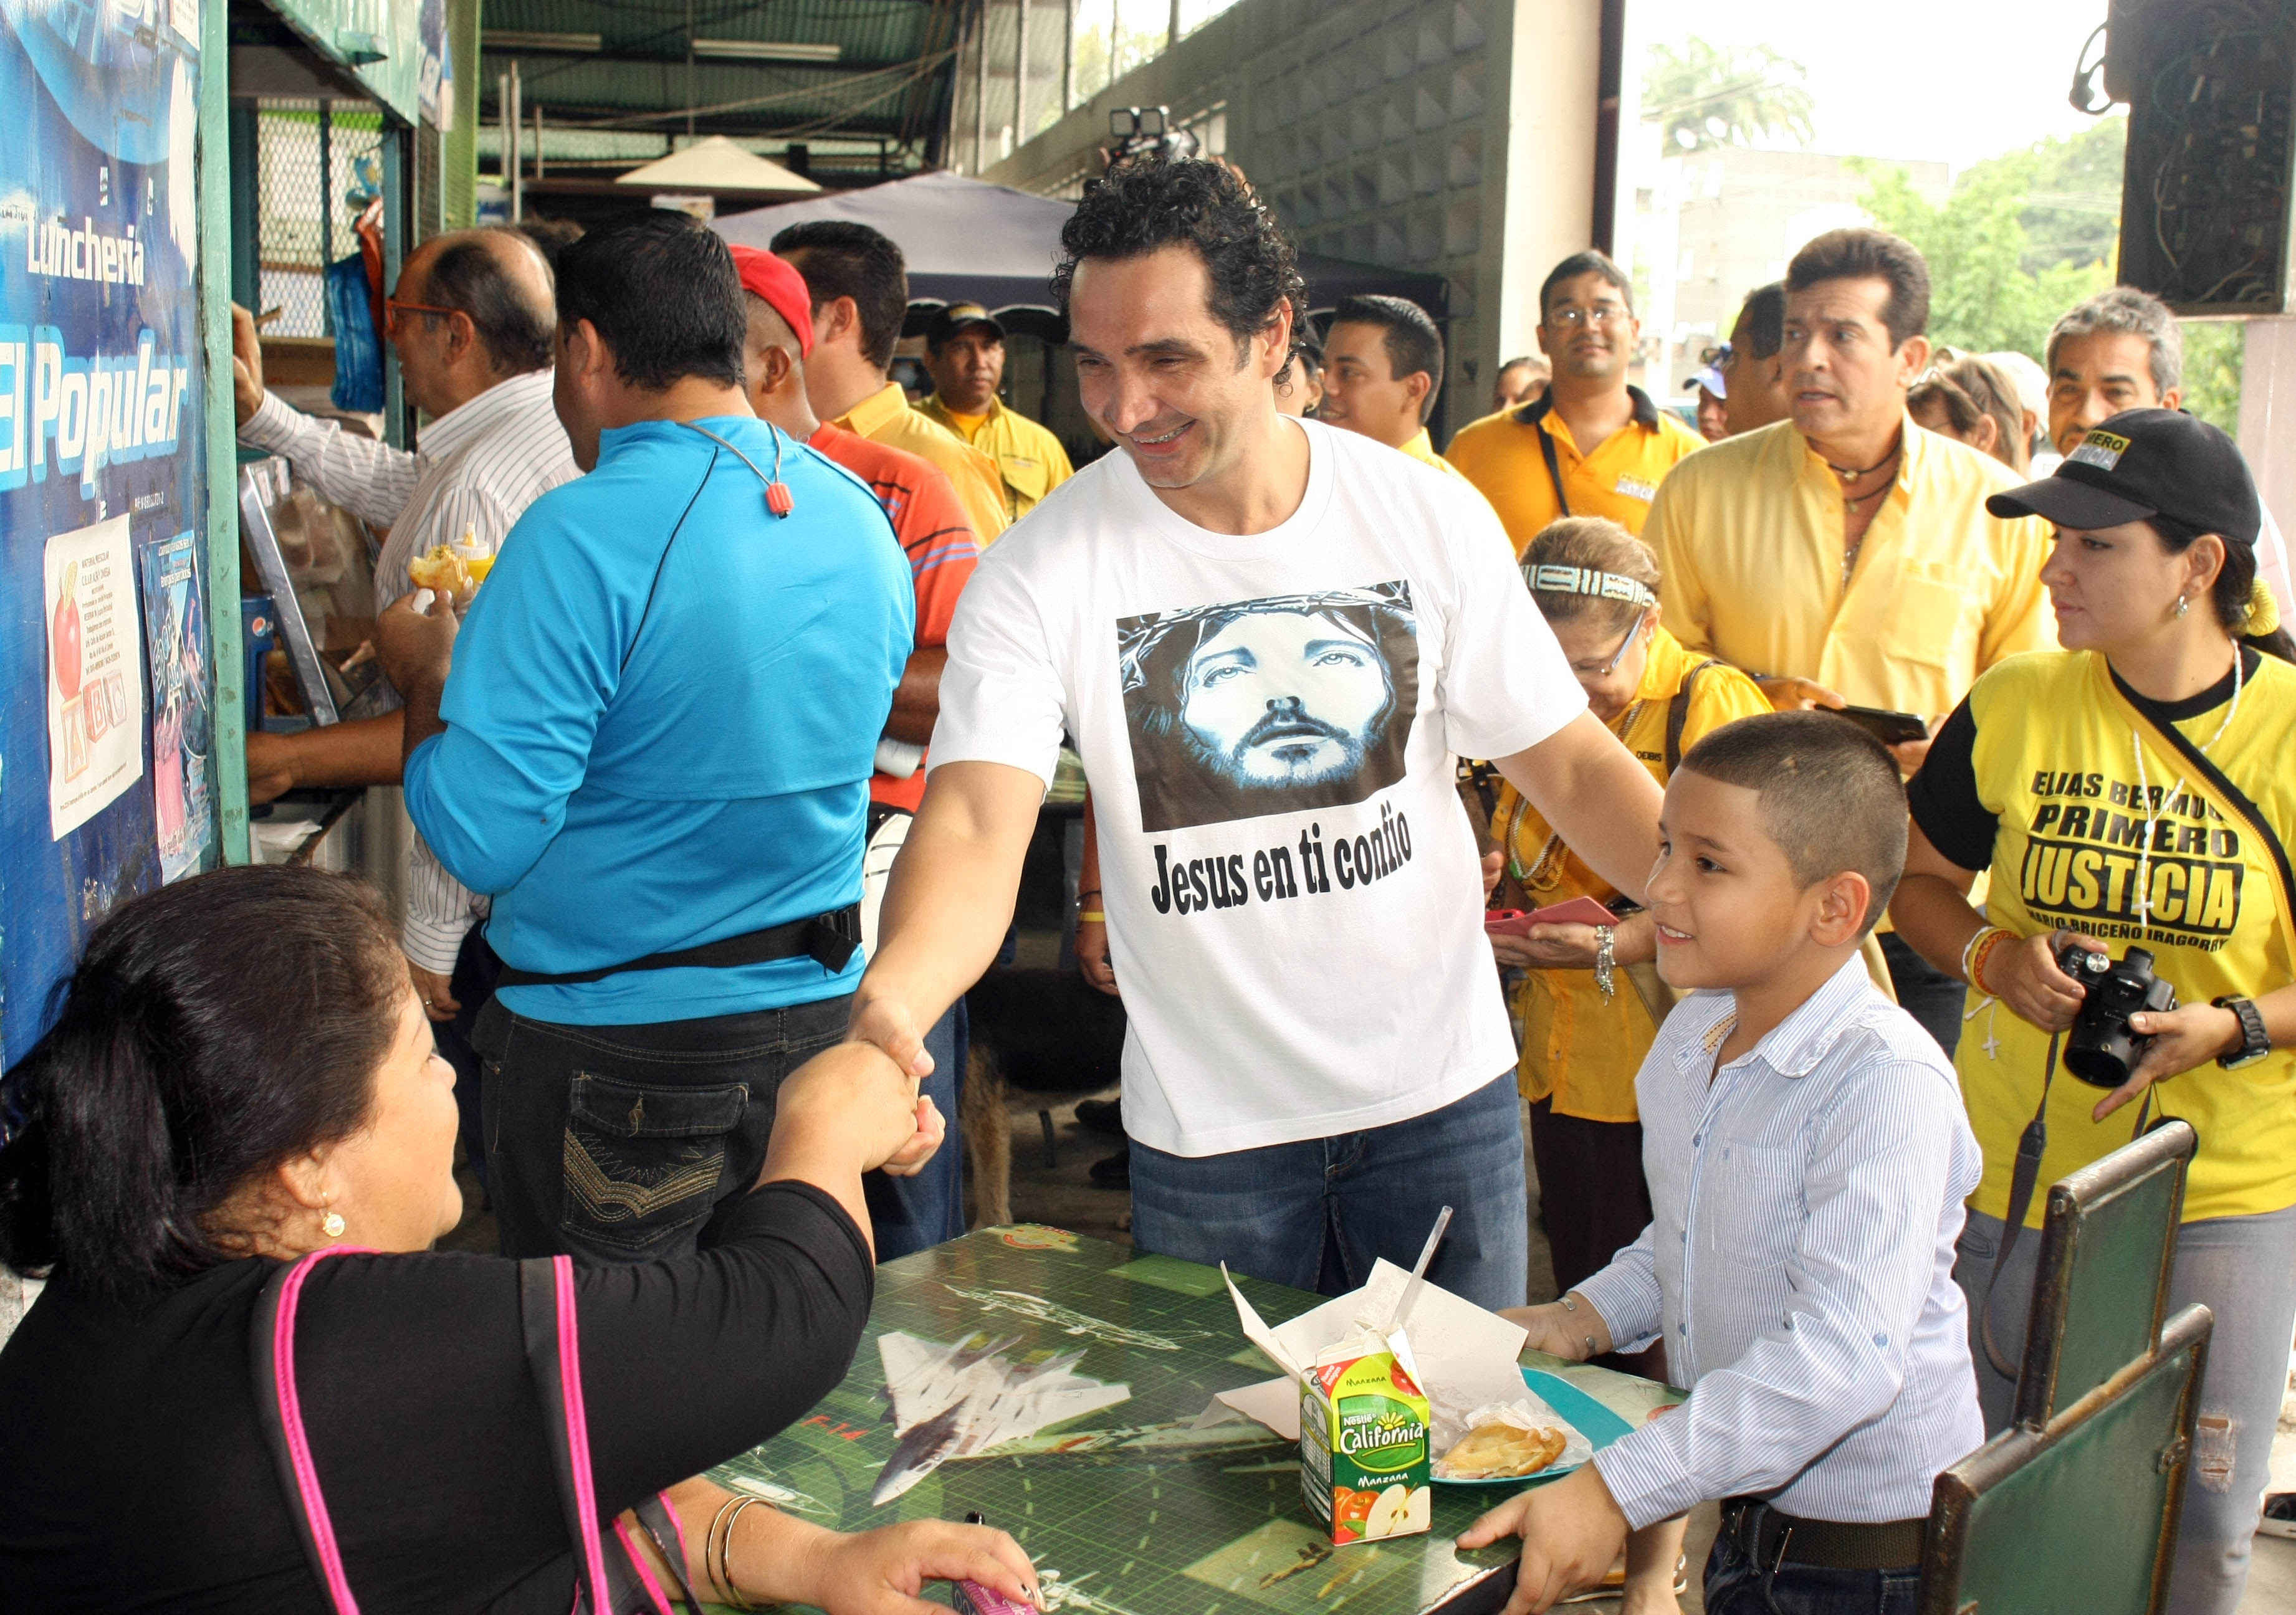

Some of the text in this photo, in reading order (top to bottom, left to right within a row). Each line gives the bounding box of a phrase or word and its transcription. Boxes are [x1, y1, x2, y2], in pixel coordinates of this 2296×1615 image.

[34, 343, 187, 485] Popular
[2031, 771, 2103, 797] ELIAS
[2030, 804, 2239, 858] PRIMERO
[1151, 799, 1412, 915] Jesus en ti confio
[2023, 844, 2234, 929] JUSTICIA
[2069, 918, 2142, 940] BRICEÑO
[1346, 1376, 1386, 1387] Manzana
[1340, 1422, 1424, 1455] California
[1357, 1472, 1409, 1488] Manzana
